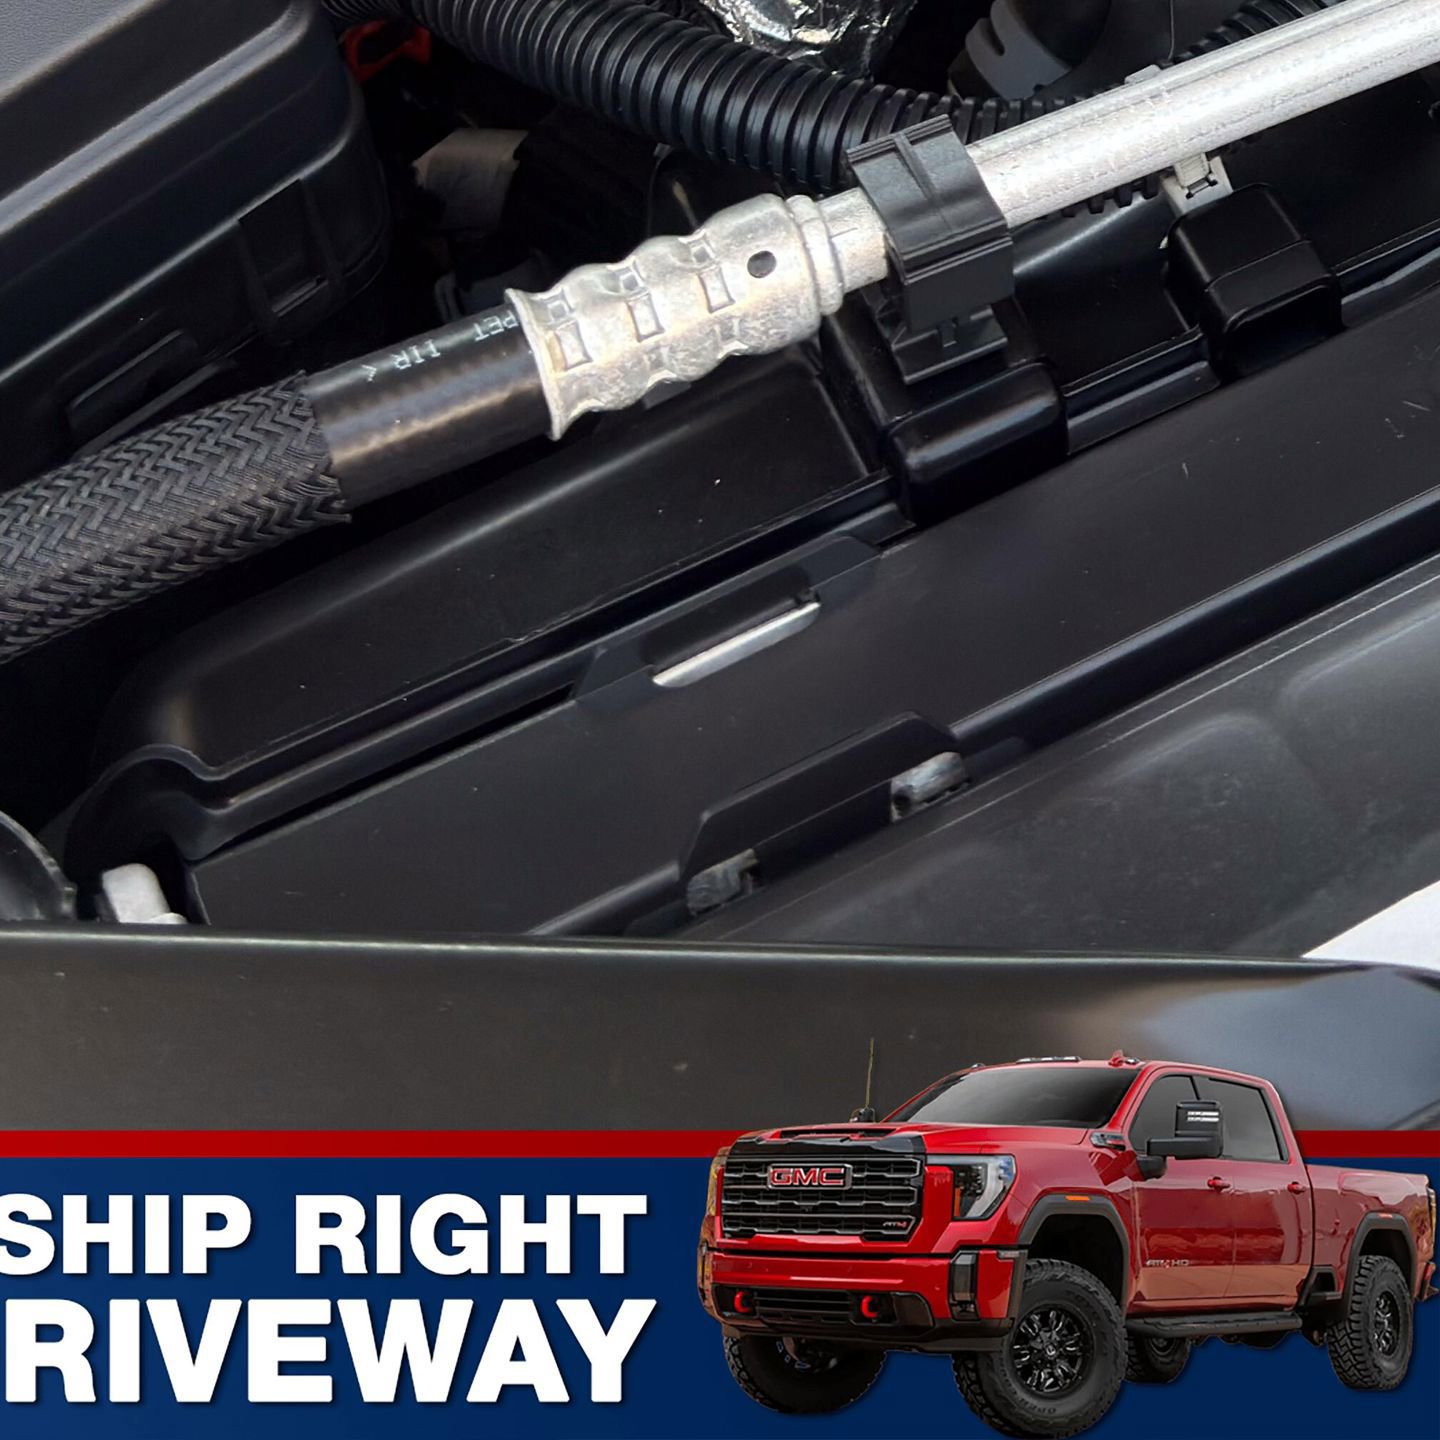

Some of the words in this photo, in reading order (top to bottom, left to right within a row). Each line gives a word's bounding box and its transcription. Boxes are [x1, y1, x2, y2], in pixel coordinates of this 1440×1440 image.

[474, 309, 519, 342] PET
[390, 338, 441, 370] IIR
[771, 1167, 845, 1186] GMC
